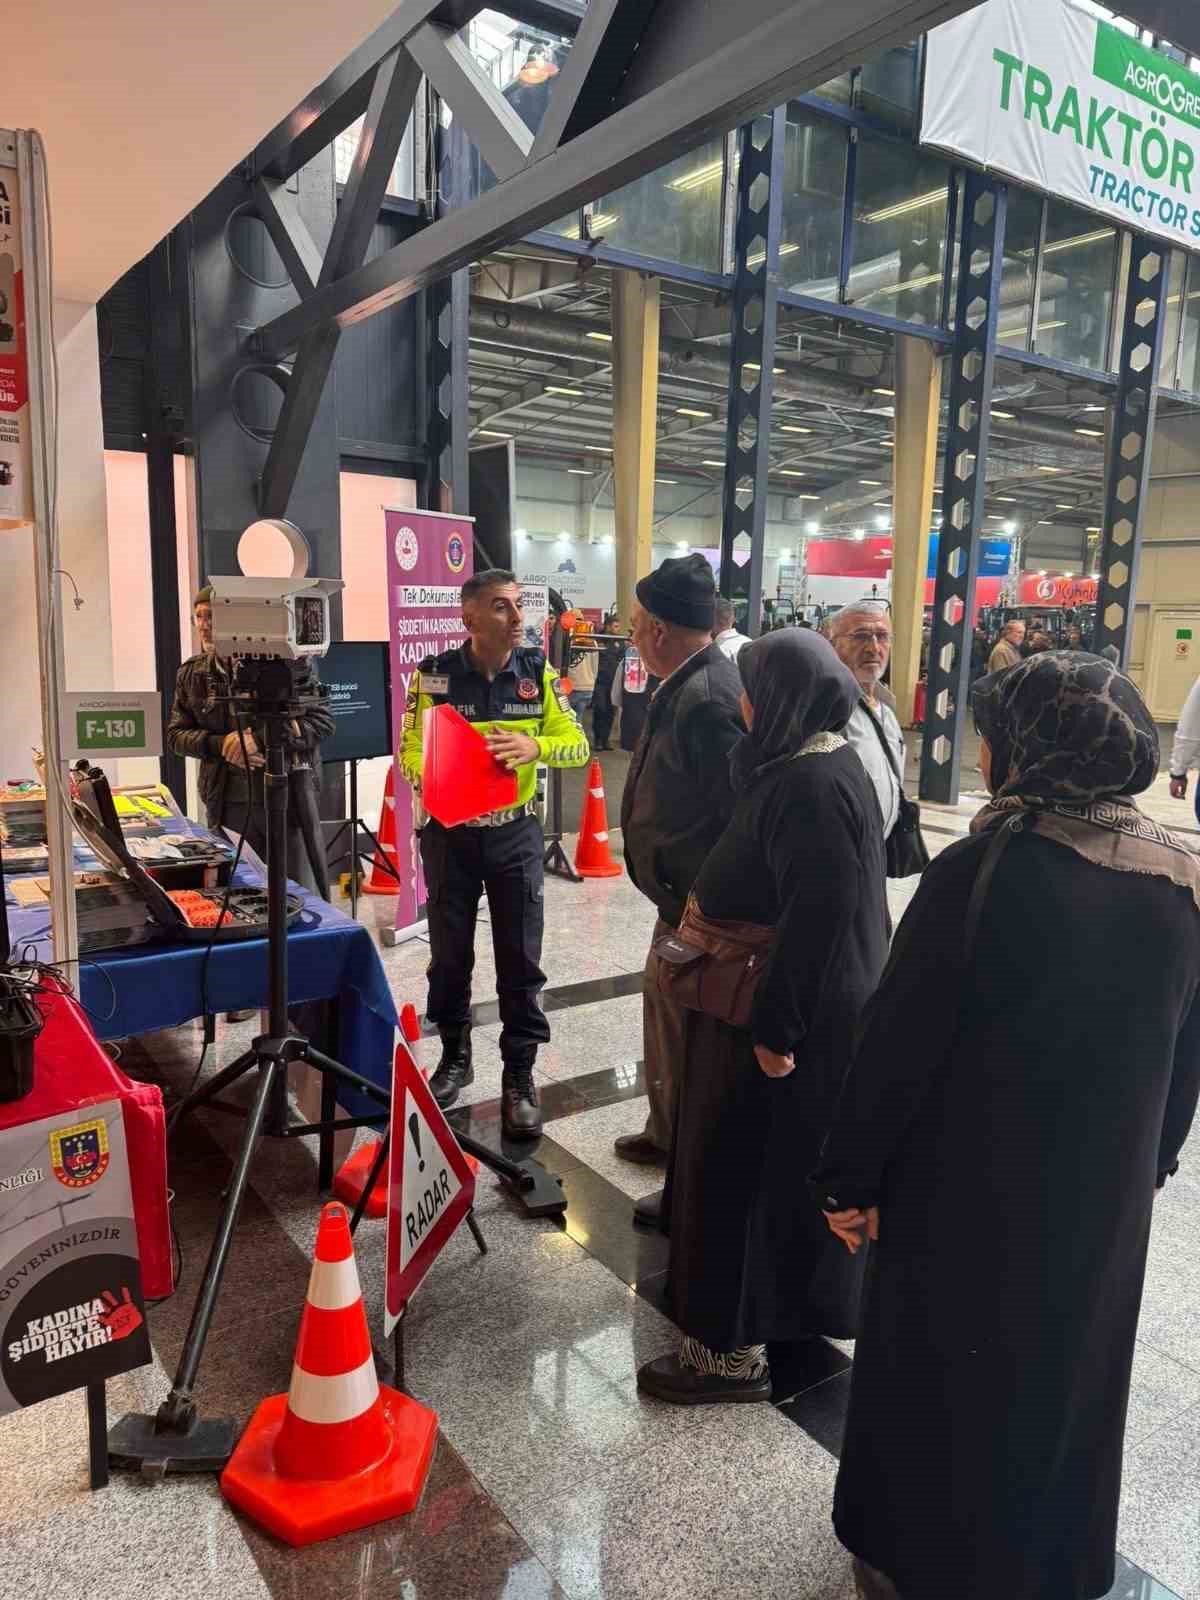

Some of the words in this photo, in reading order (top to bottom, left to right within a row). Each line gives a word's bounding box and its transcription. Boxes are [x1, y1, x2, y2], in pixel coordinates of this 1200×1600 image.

[992, 47, 1195, 194] TRAKTÖR
[403, 587, 417, 605] Tek
[85, 719, 137, 739] F-130
[405, 1168, 452, 1248] RADAR
[26, 1298, 105, 1336] KADINA
[8, 1314, 101, 1362] ŞİDDETE
[44, 1325, 113, 1363] HAYIR!
